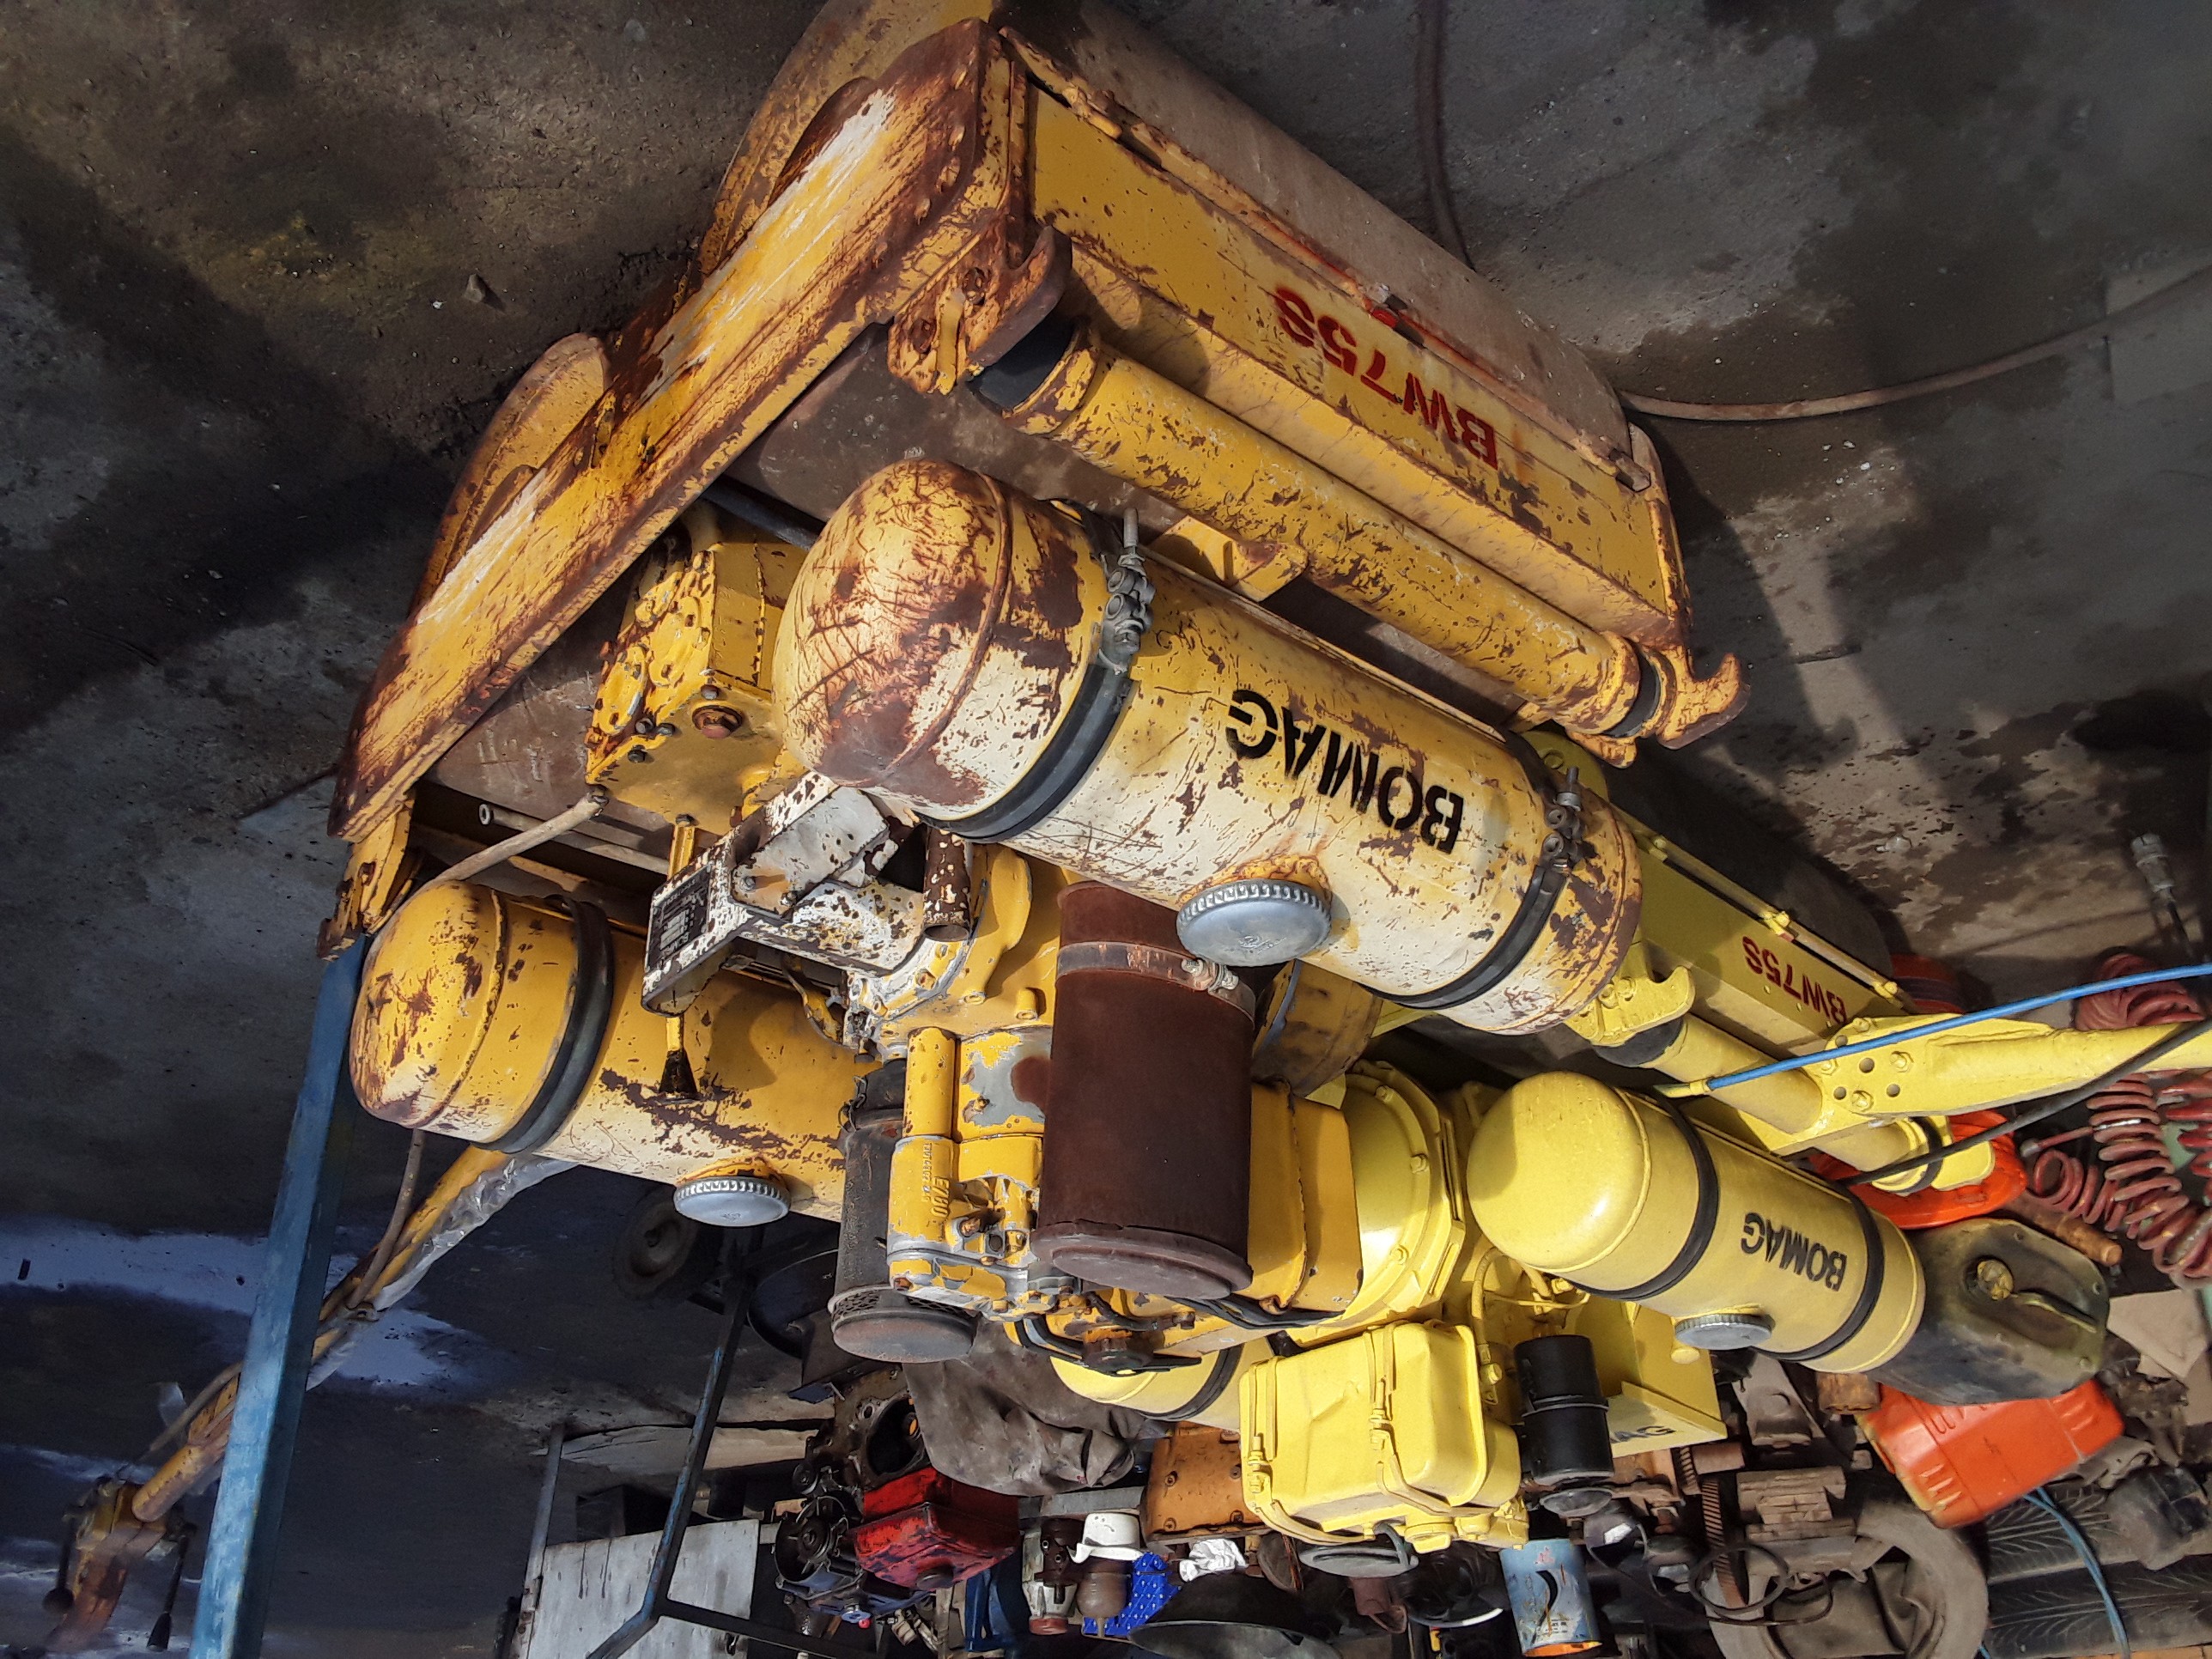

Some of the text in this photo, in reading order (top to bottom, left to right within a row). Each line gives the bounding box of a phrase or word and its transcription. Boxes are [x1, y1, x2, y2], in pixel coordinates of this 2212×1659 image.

[1275, 287, 1496, 471] BW75S
[1225, 689, 1464, 855] BOMAG
[1742, 936, 1846, 1026] BW75S
[1739, 1211, 1848, 1292] BOMAG
